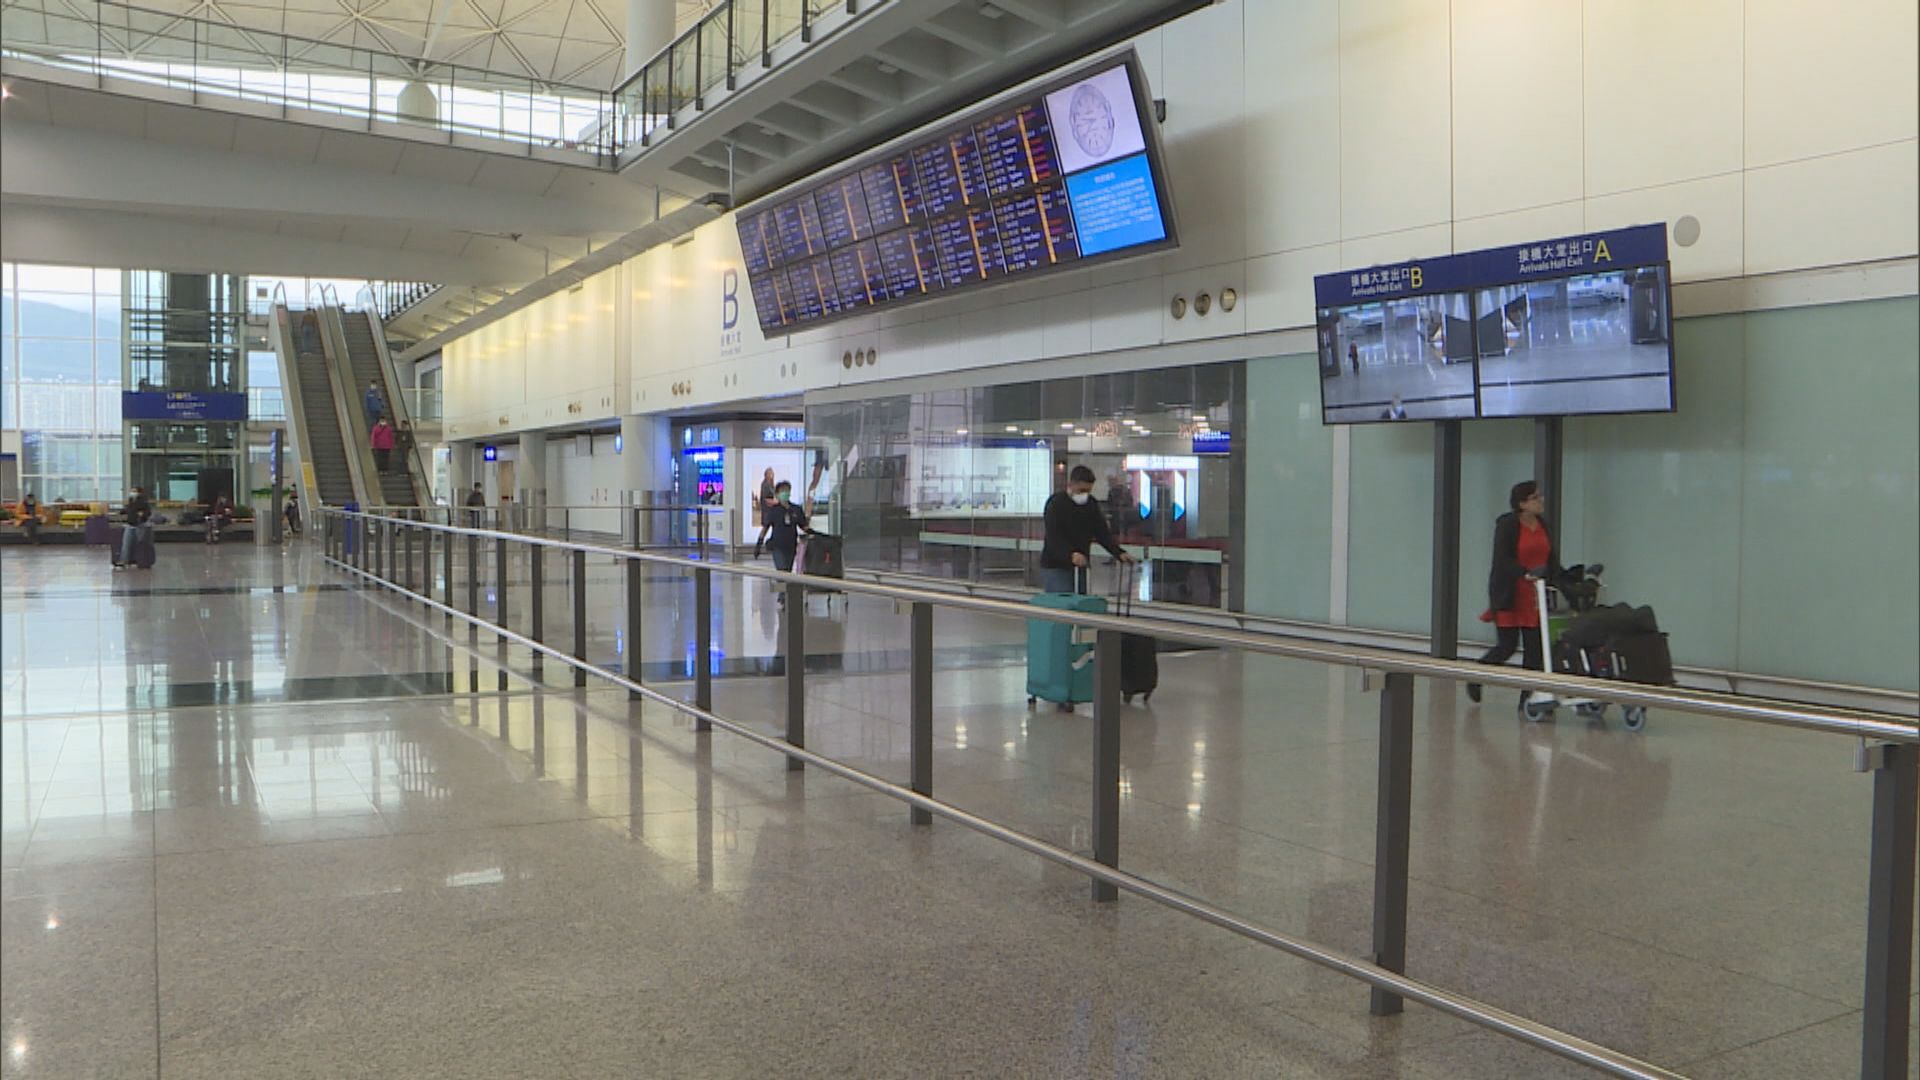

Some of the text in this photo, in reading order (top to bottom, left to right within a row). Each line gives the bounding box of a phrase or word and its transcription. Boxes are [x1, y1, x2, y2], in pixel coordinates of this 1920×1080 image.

[1593, 239, 1612, 264] A
[1519, 255, 1583, 274] Arrivals Hall Exit
[1410, 266, 1423, 289] B
[723, 267, 739, 331] B
